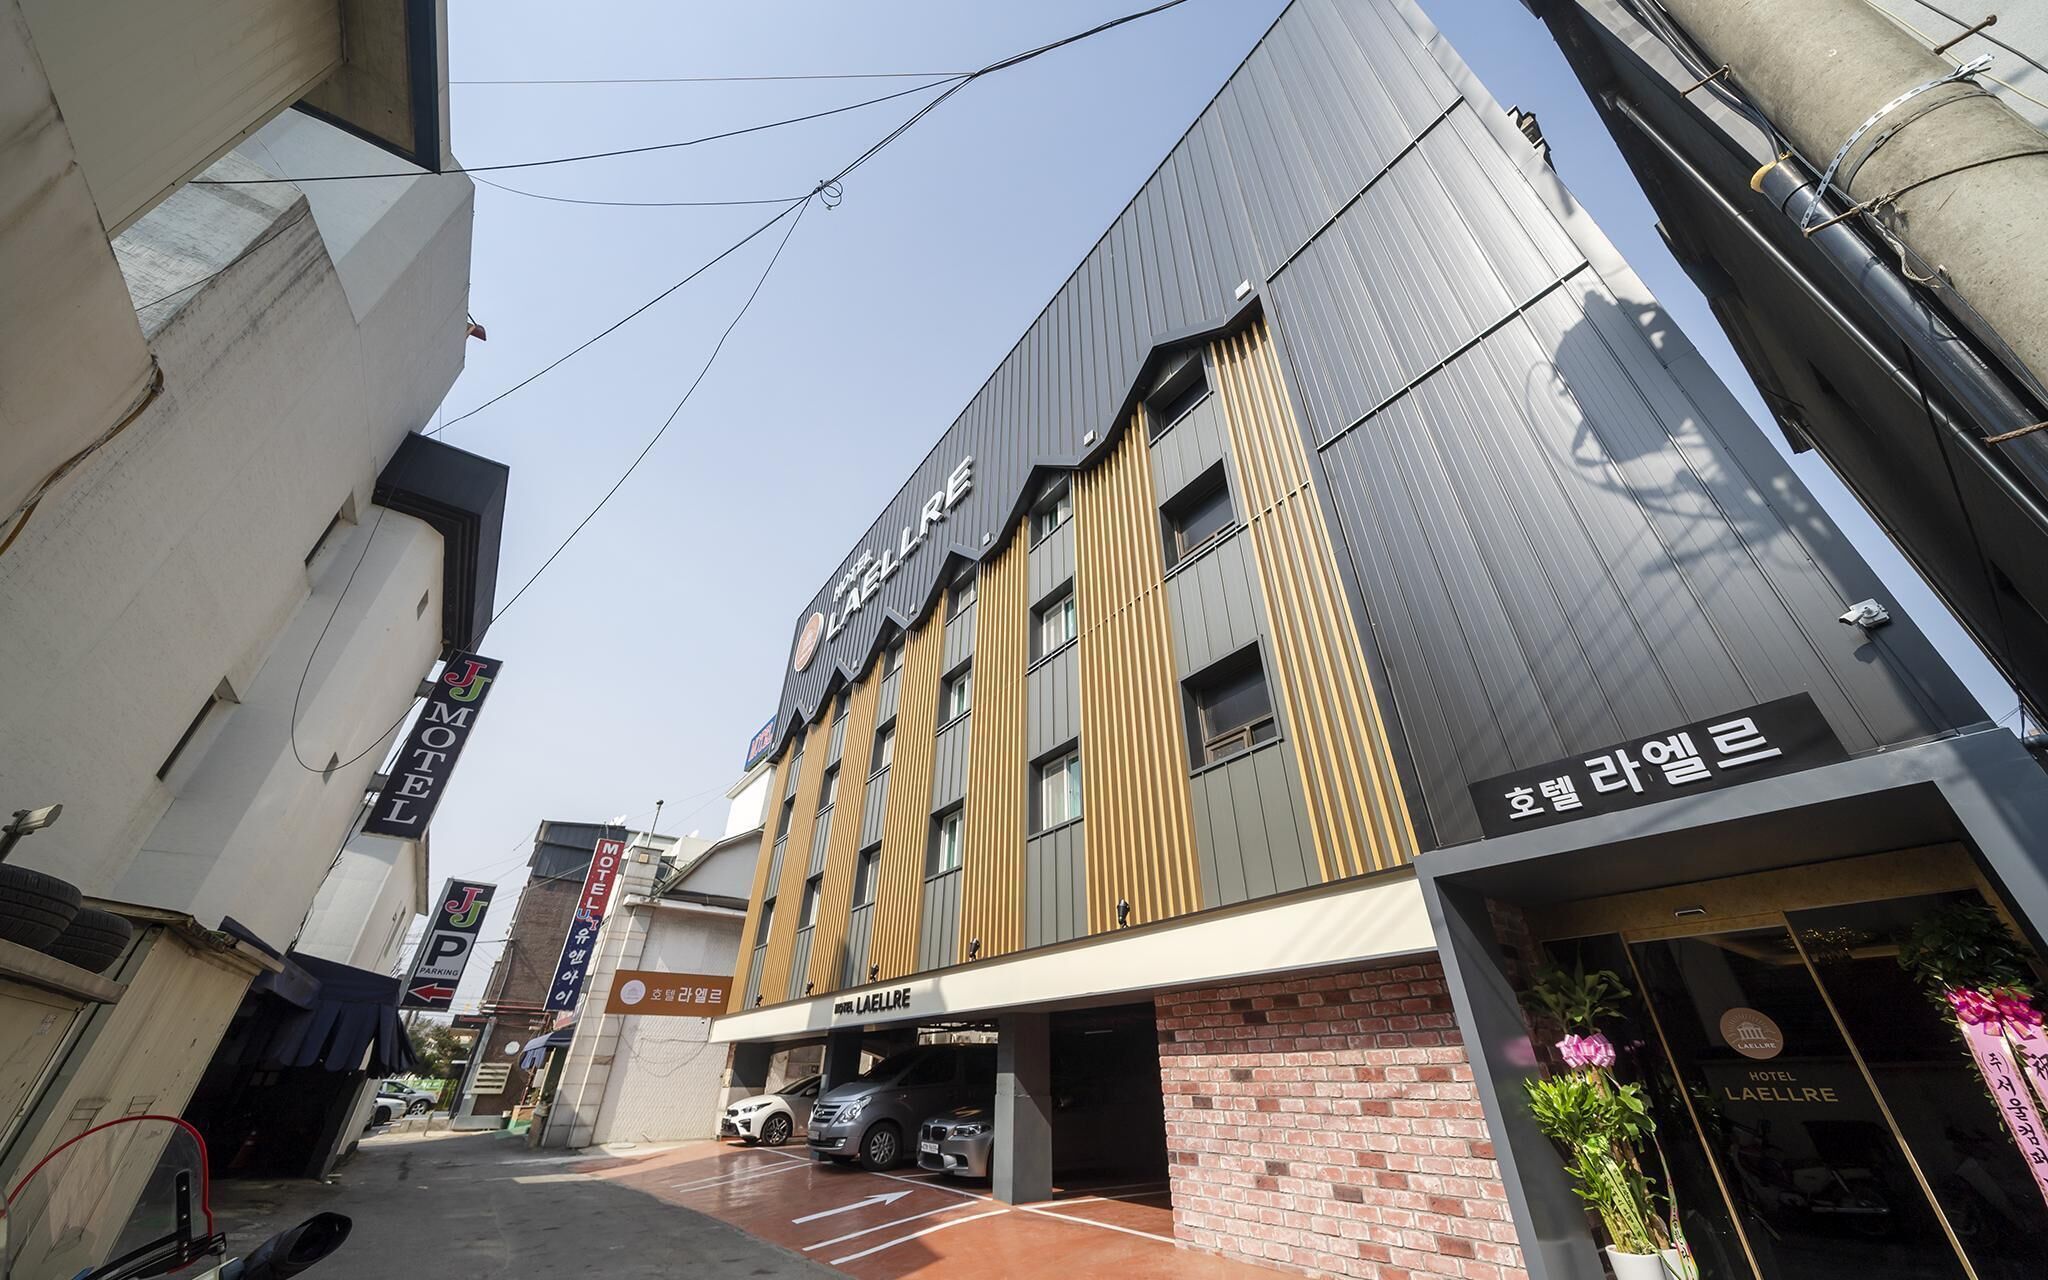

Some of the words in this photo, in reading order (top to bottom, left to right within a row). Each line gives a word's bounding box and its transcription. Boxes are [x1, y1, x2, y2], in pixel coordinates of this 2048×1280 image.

[826, 455, 973, 642] LAELLRE
[833, 549, 873, 602] HOTEL
[443, 659, 492, 702] JJ
[382, 701, 474, 825] MOTEL
[1504, 774, 1583, 819] 호텔
[1584, 716, 1783, 795] 라엘르
[586, 842, 619, 910] MOTEL
[444, 886, 489, 928] JJ
[424, 934, 468, 967] P
[554, 927, 591, 1006] 유앤아이
[420, 967, 459, 977] PARKING
[650, 987, 676, 1002] 호텔
[677, 986, 723, 1004] 라엘르
[834, 1000, 855, 1015] HOTEL
[856, 988, 912, 1015] LAELLRE
[1738, 1042, 1777, 1050] LAELLRE
[1724, 1087, 1840, 1102] LAELLRE
[1748, 1071, 1798, 1081] HOTEL
